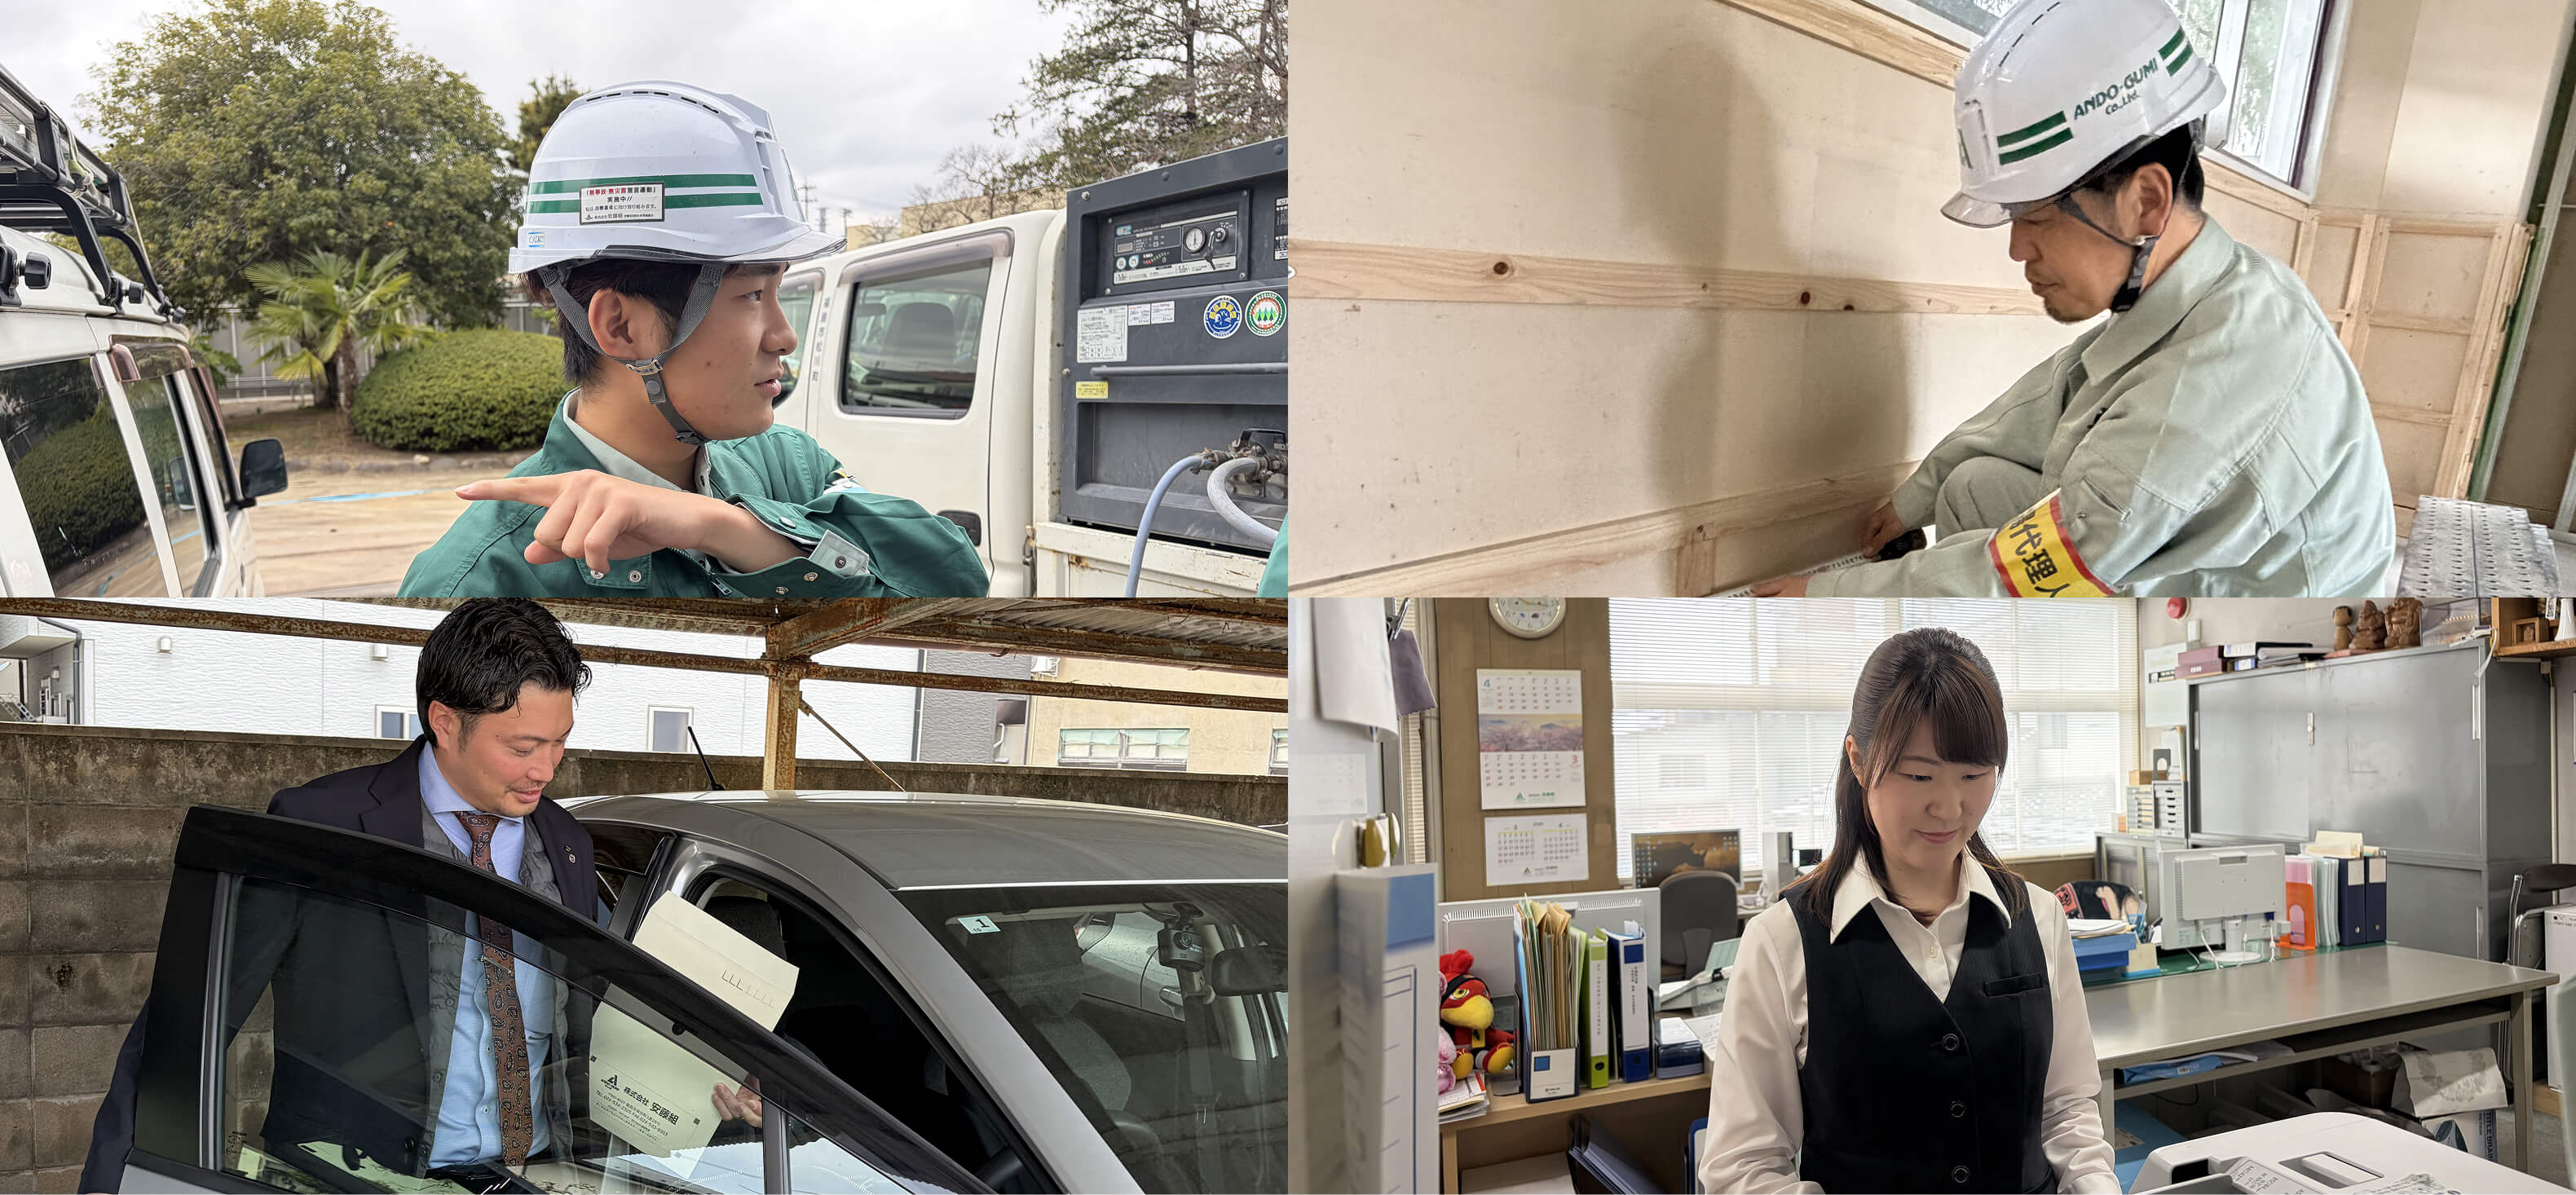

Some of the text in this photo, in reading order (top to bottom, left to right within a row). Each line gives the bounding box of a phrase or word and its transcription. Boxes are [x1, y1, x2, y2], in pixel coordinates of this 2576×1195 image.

[2073, 57, 2159, 121] ANDO-GUMI
[1484, 678, 1491, 688] 4
[975, 919, 990, 928] 1
[624, 1087, 650, 1106] 株式会社
[650, 1102, 679, 1125] 安藤組
